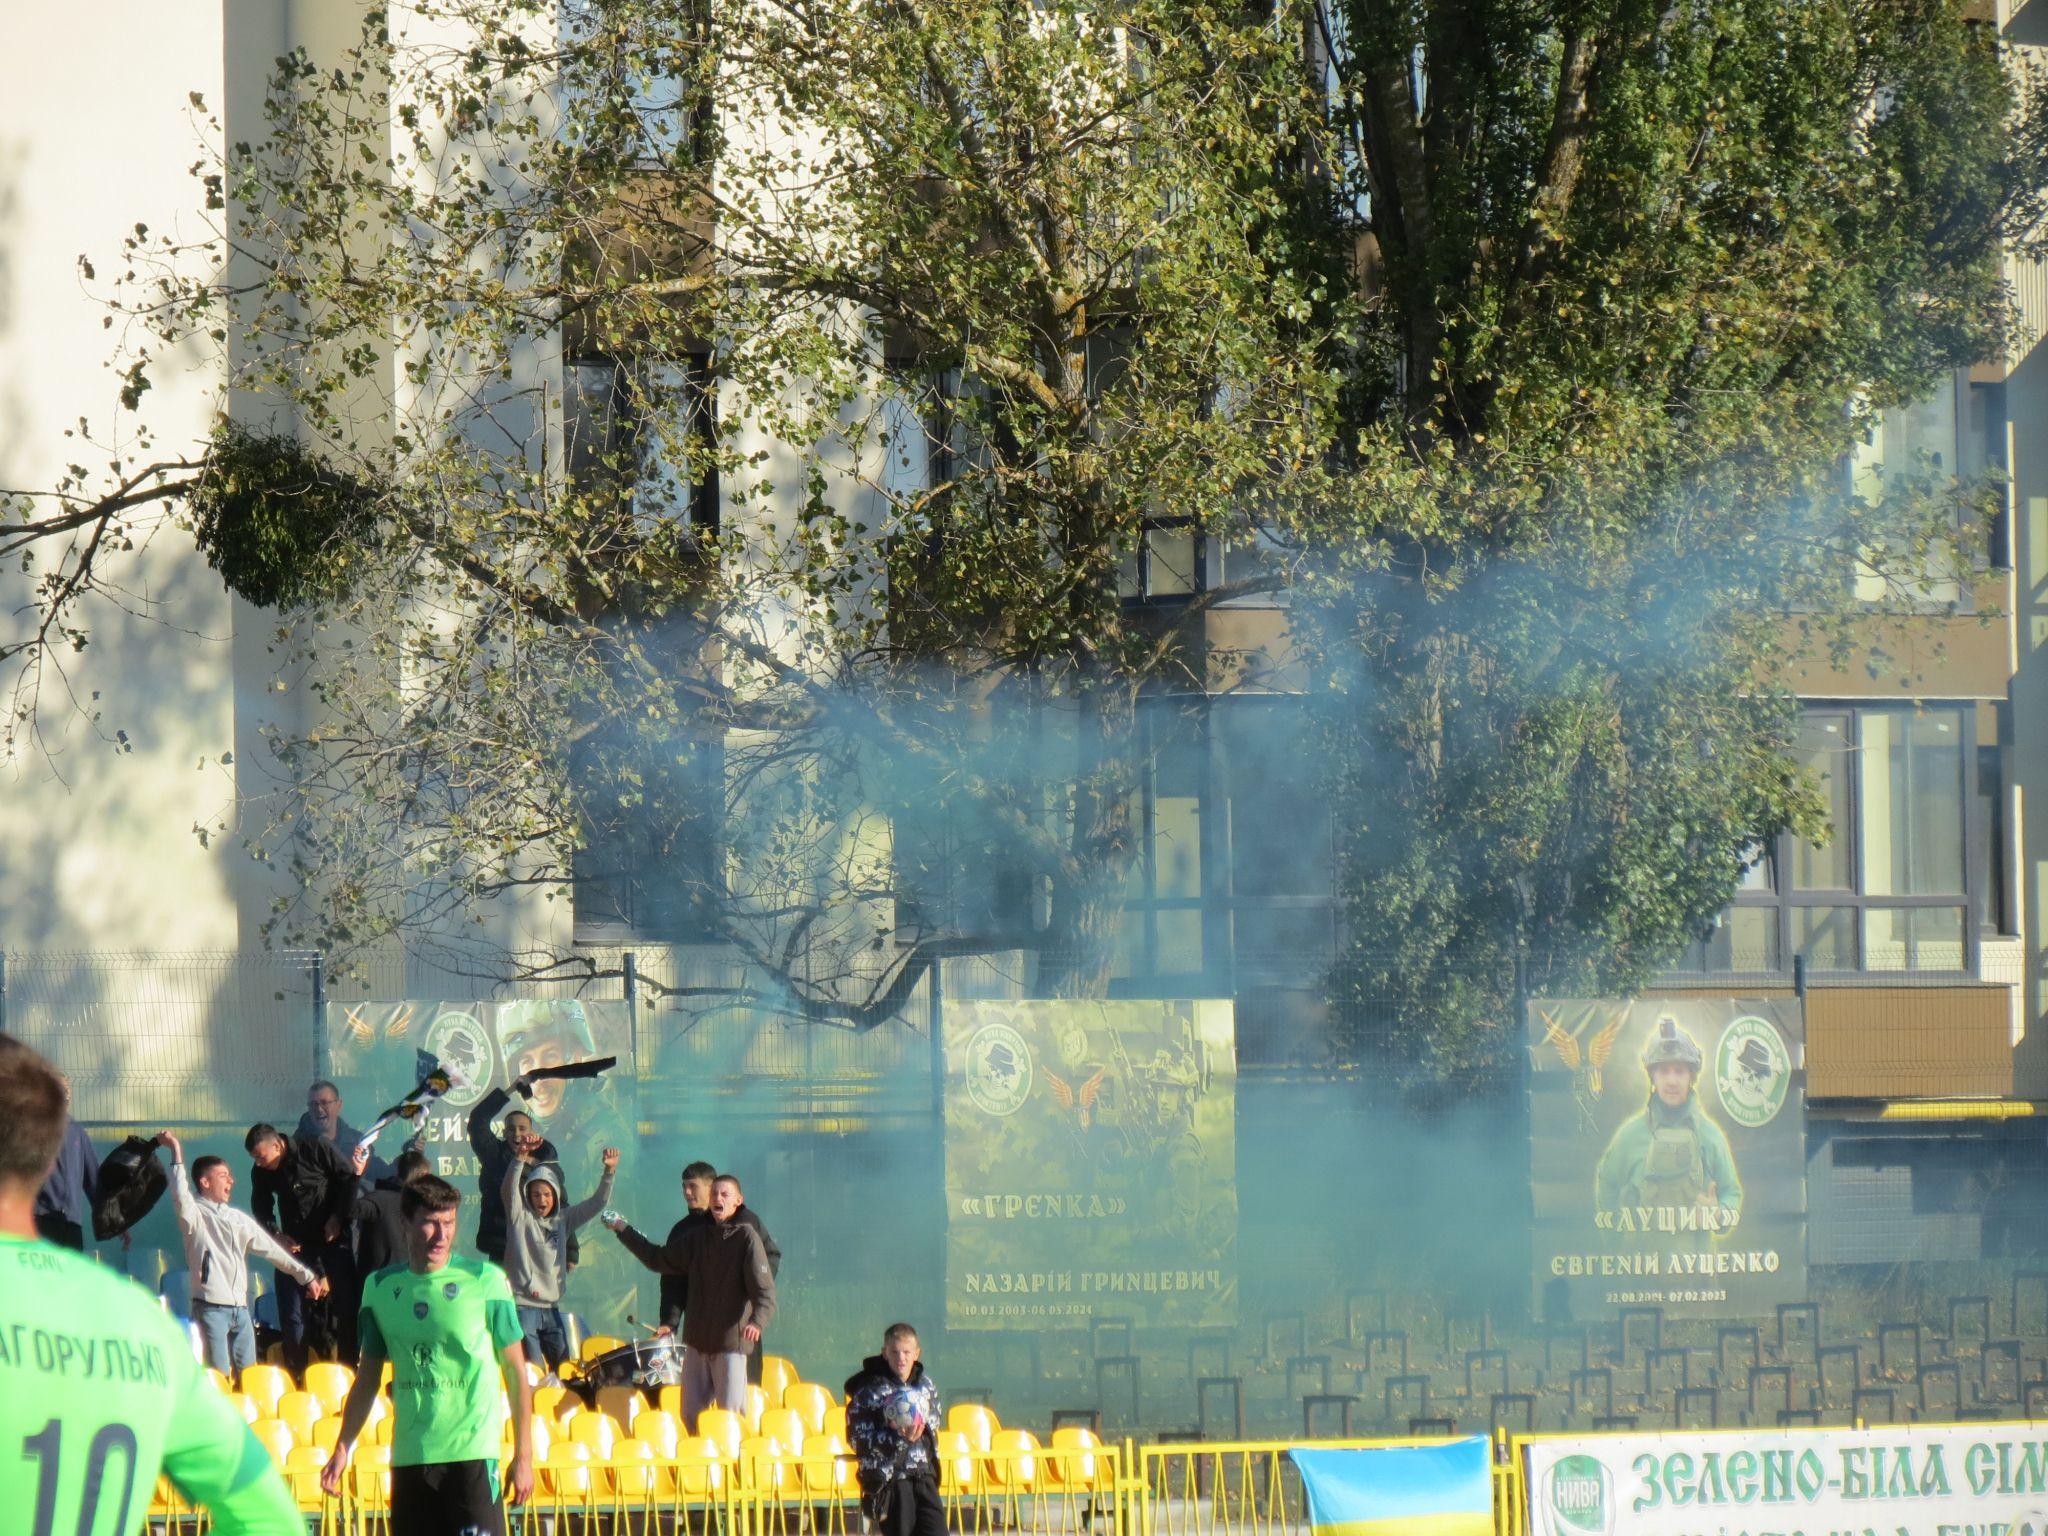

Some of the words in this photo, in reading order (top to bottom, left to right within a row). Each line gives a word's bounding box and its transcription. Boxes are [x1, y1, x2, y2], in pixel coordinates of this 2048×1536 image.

[1594, 1206, 1741, 1234] «ЛУЦИК»
[1551, 1252, 1660, 1276] ЄВГЕНІЙ
[1667, 1250, 1780, 1276] ЛУЦЕНКО
[965, 1270, 1072, 1294] НАЗАРІЙ
[1080, 1269, 1221, 1295] ГРИНЦЕВИЧ
[23, 1418, 138, 1536] 10
[1556, 1480, 1600, 1509] НИВА
